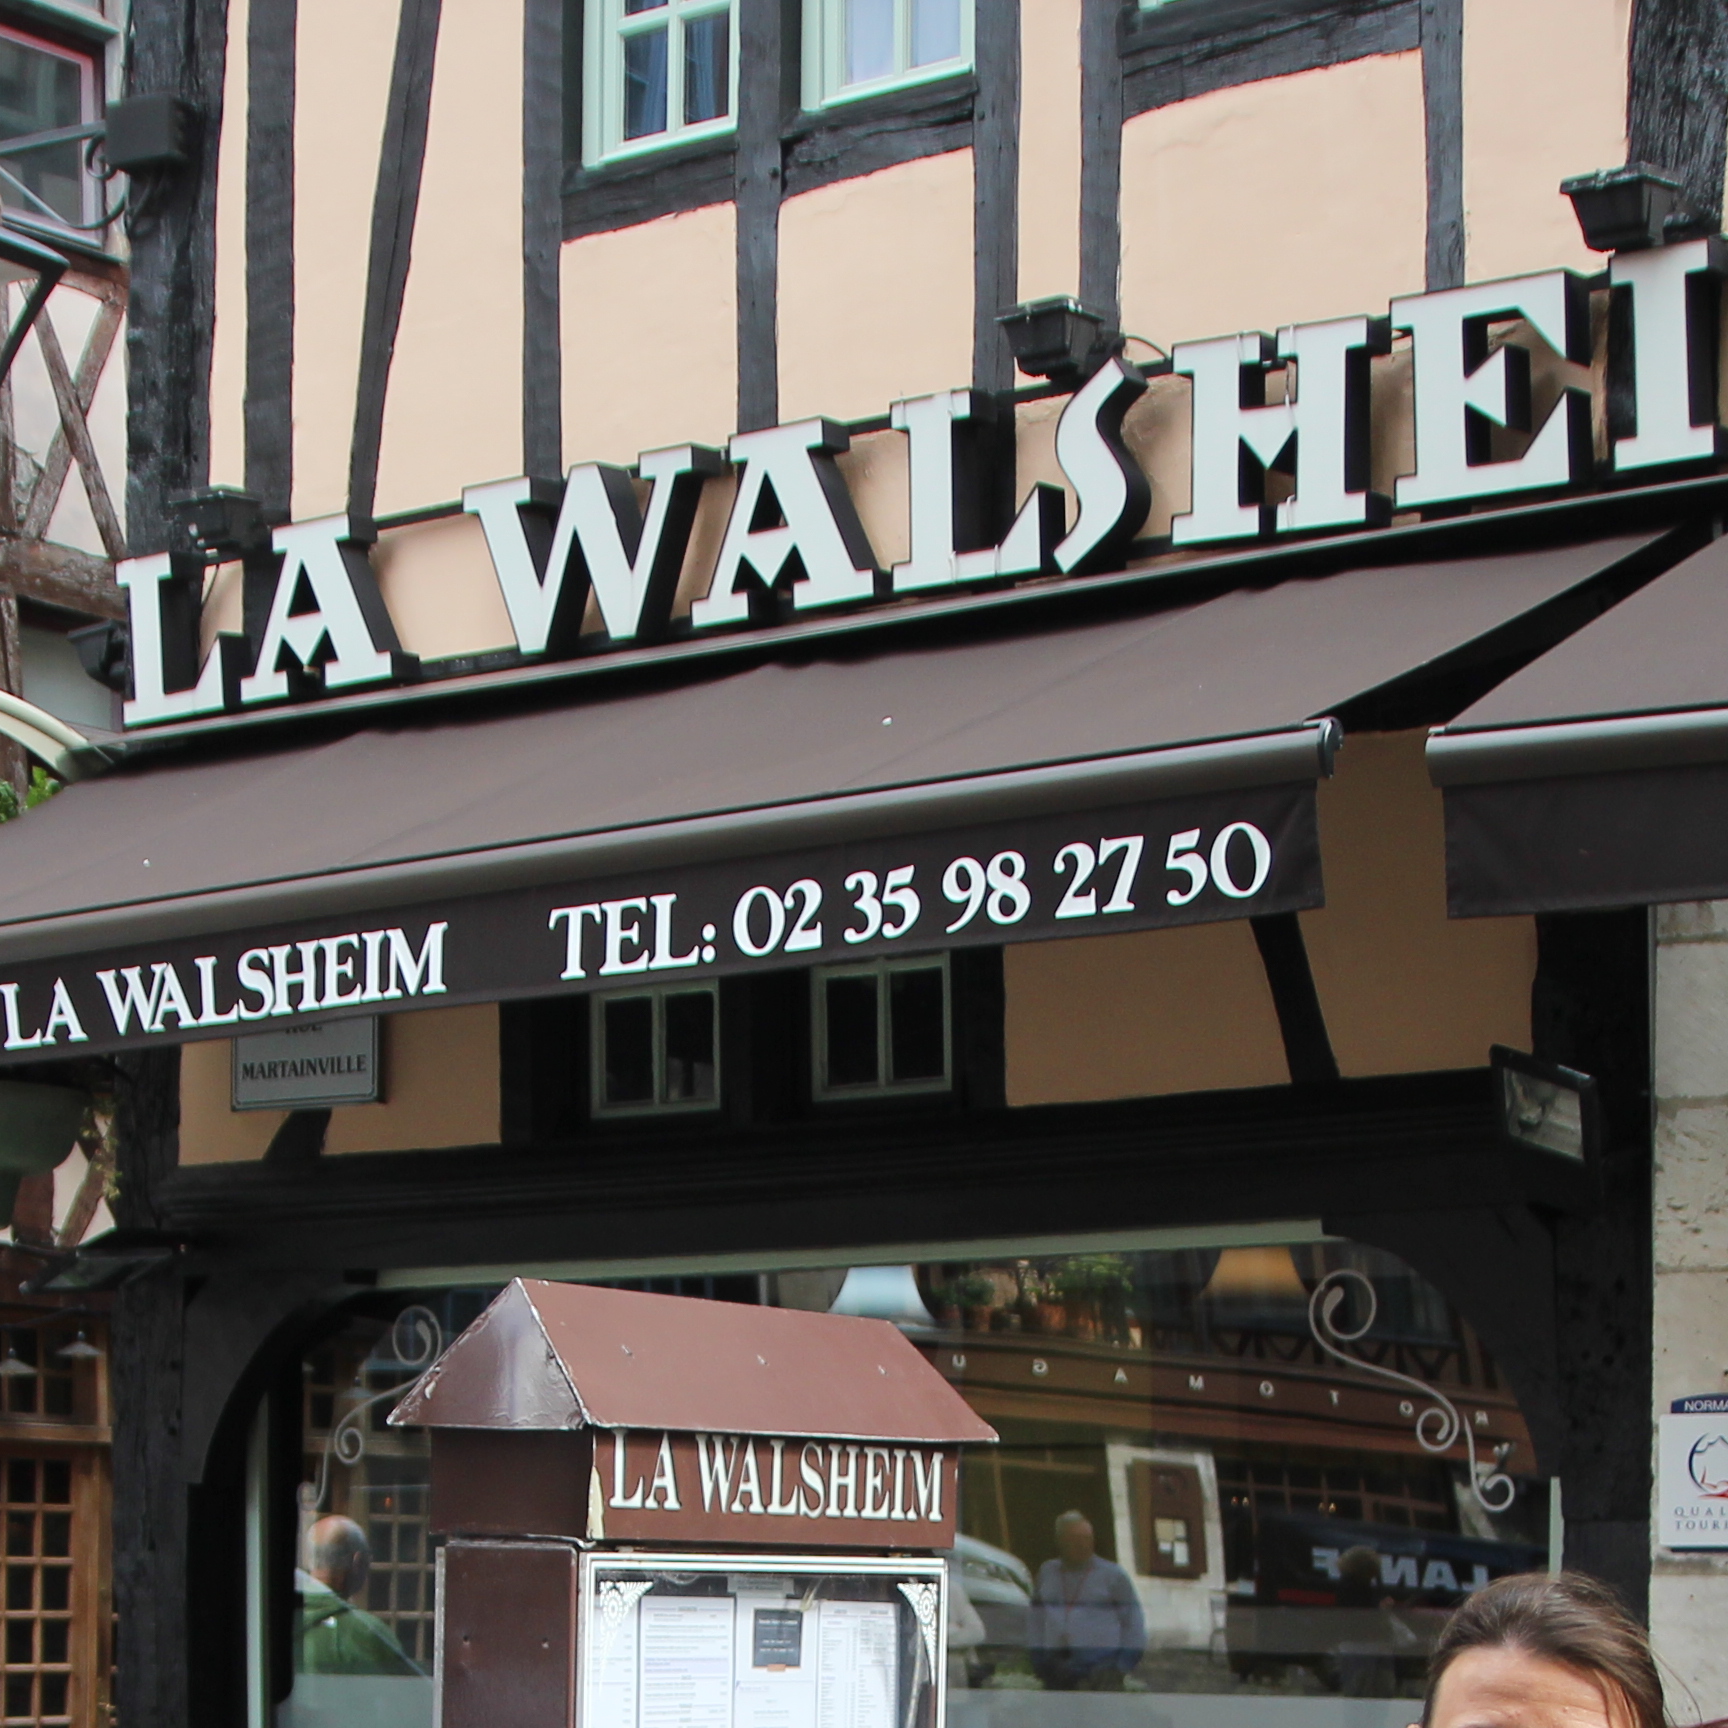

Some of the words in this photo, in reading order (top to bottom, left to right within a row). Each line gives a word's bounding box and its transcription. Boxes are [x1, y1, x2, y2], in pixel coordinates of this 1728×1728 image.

[115, 510, 396, 726] LA
[547, 892, 718, 983] TEL:
[731, 877, 825, 959] 02
[842, 863, 922, 944] 35
[940, 849, 1033, 935] 98
[1052, 833, 1145, 921] 27
[1163, 820, 1272, 909] 50
[94, 920, 449, 1037] WALSHEIM
[241, 1054, 367, 1080] MARTAINVILLE
[608, 1427, 682, 1511] LA
[694, 1433, 945, 1523] WALSHEIM
